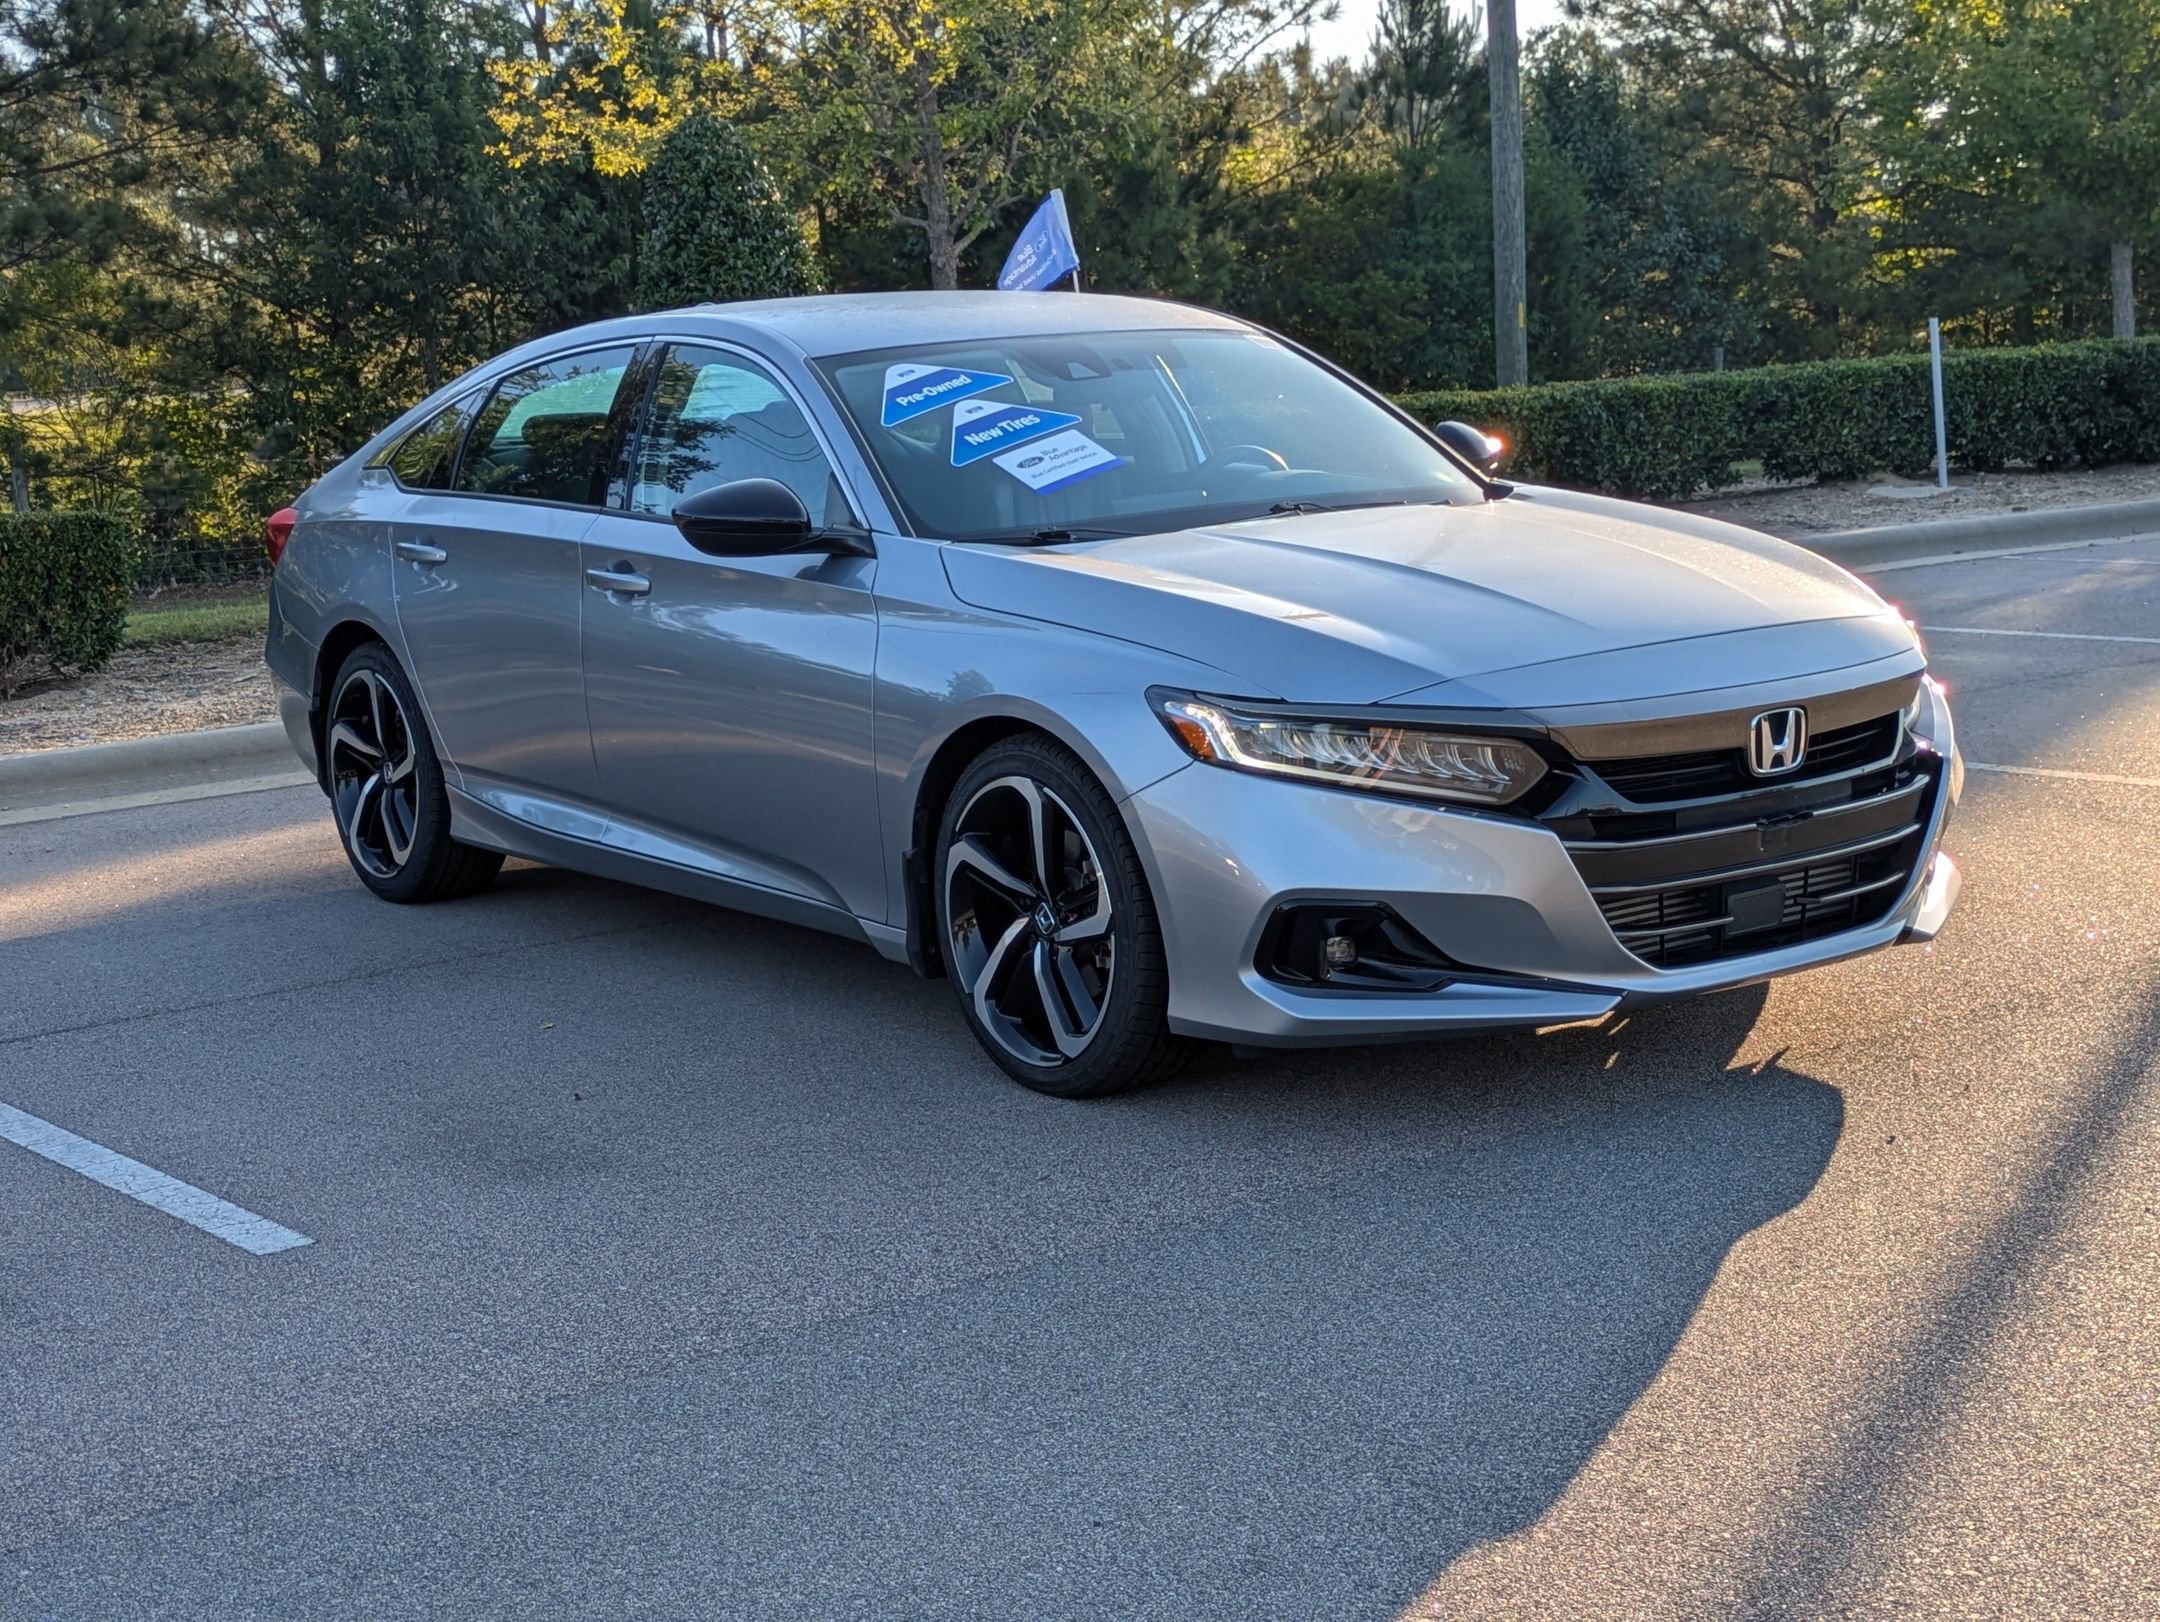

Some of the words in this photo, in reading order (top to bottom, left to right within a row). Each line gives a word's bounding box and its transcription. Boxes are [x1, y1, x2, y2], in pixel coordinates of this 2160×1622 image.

[896, 373, 973, 407] Pre-Owned
[963, 427, 1004, 446] New
[997, 414, 1041, 433] Tires
[1040, 446, 1060, 457] Blue
[1048, 444, 1088, 462] Advantage
